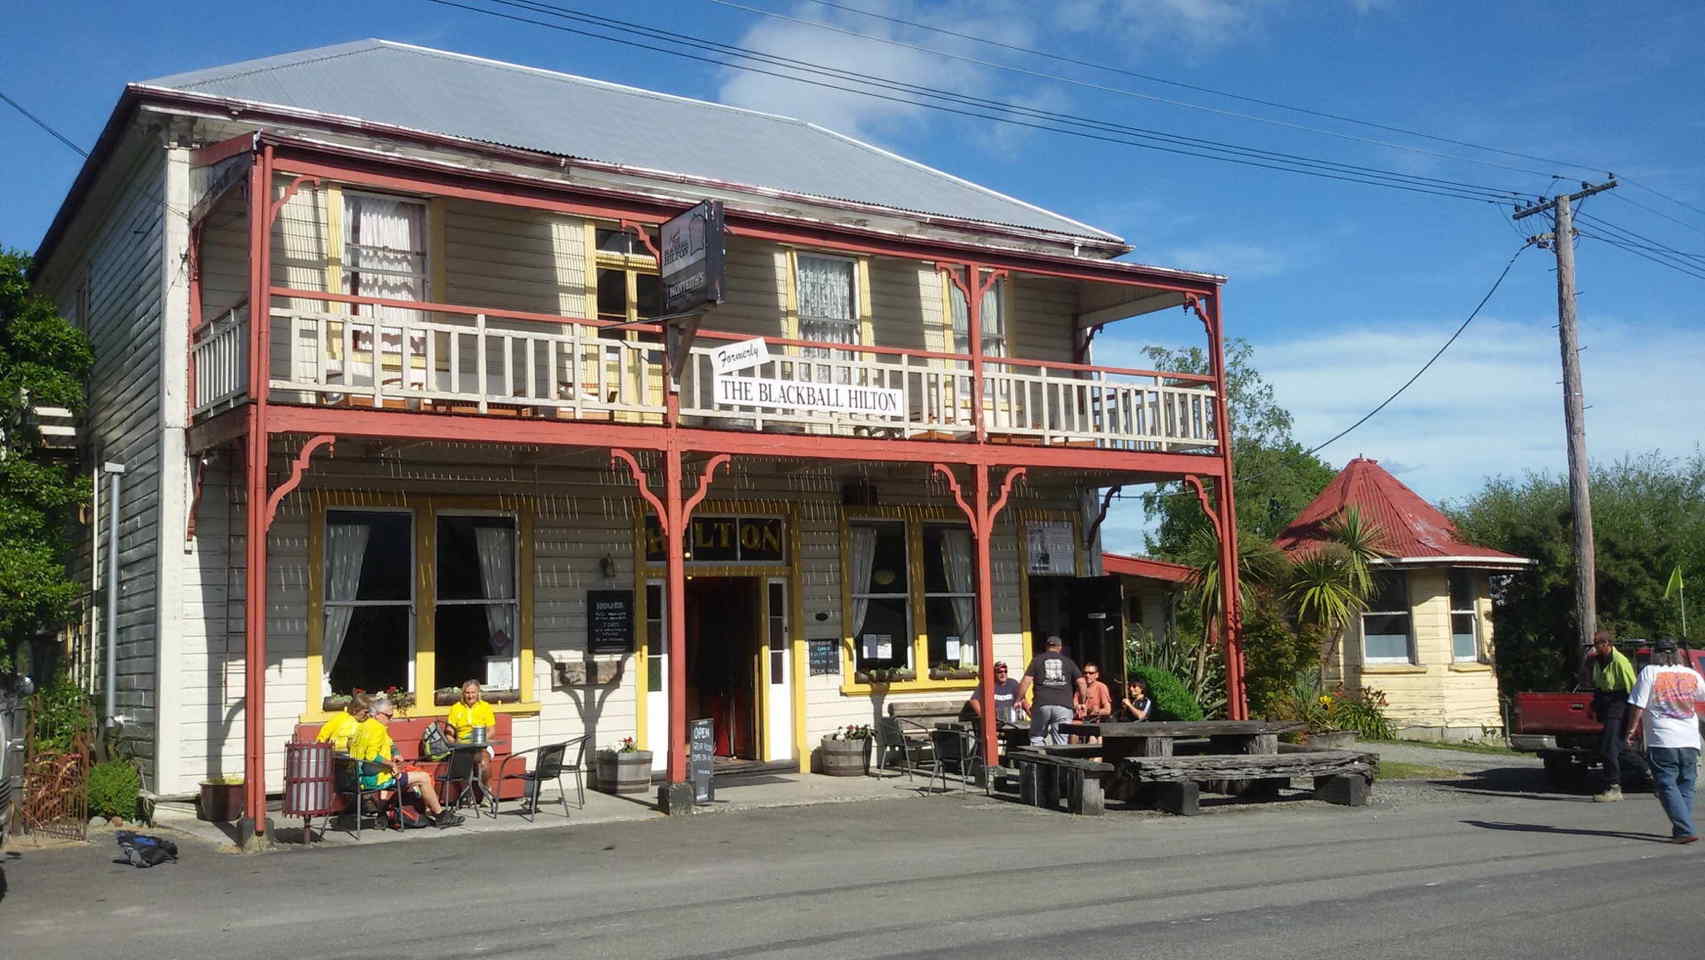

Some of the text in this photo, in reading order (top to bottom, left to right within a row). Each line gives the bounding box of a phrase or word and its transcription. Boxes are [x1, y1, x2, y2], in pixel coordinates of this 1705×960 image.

[718, 343, 760, 367] Formerly
[721, 380, 897, 411] THE BLACKBALL HILTON
[694, 727, 710, 739] OPEN
